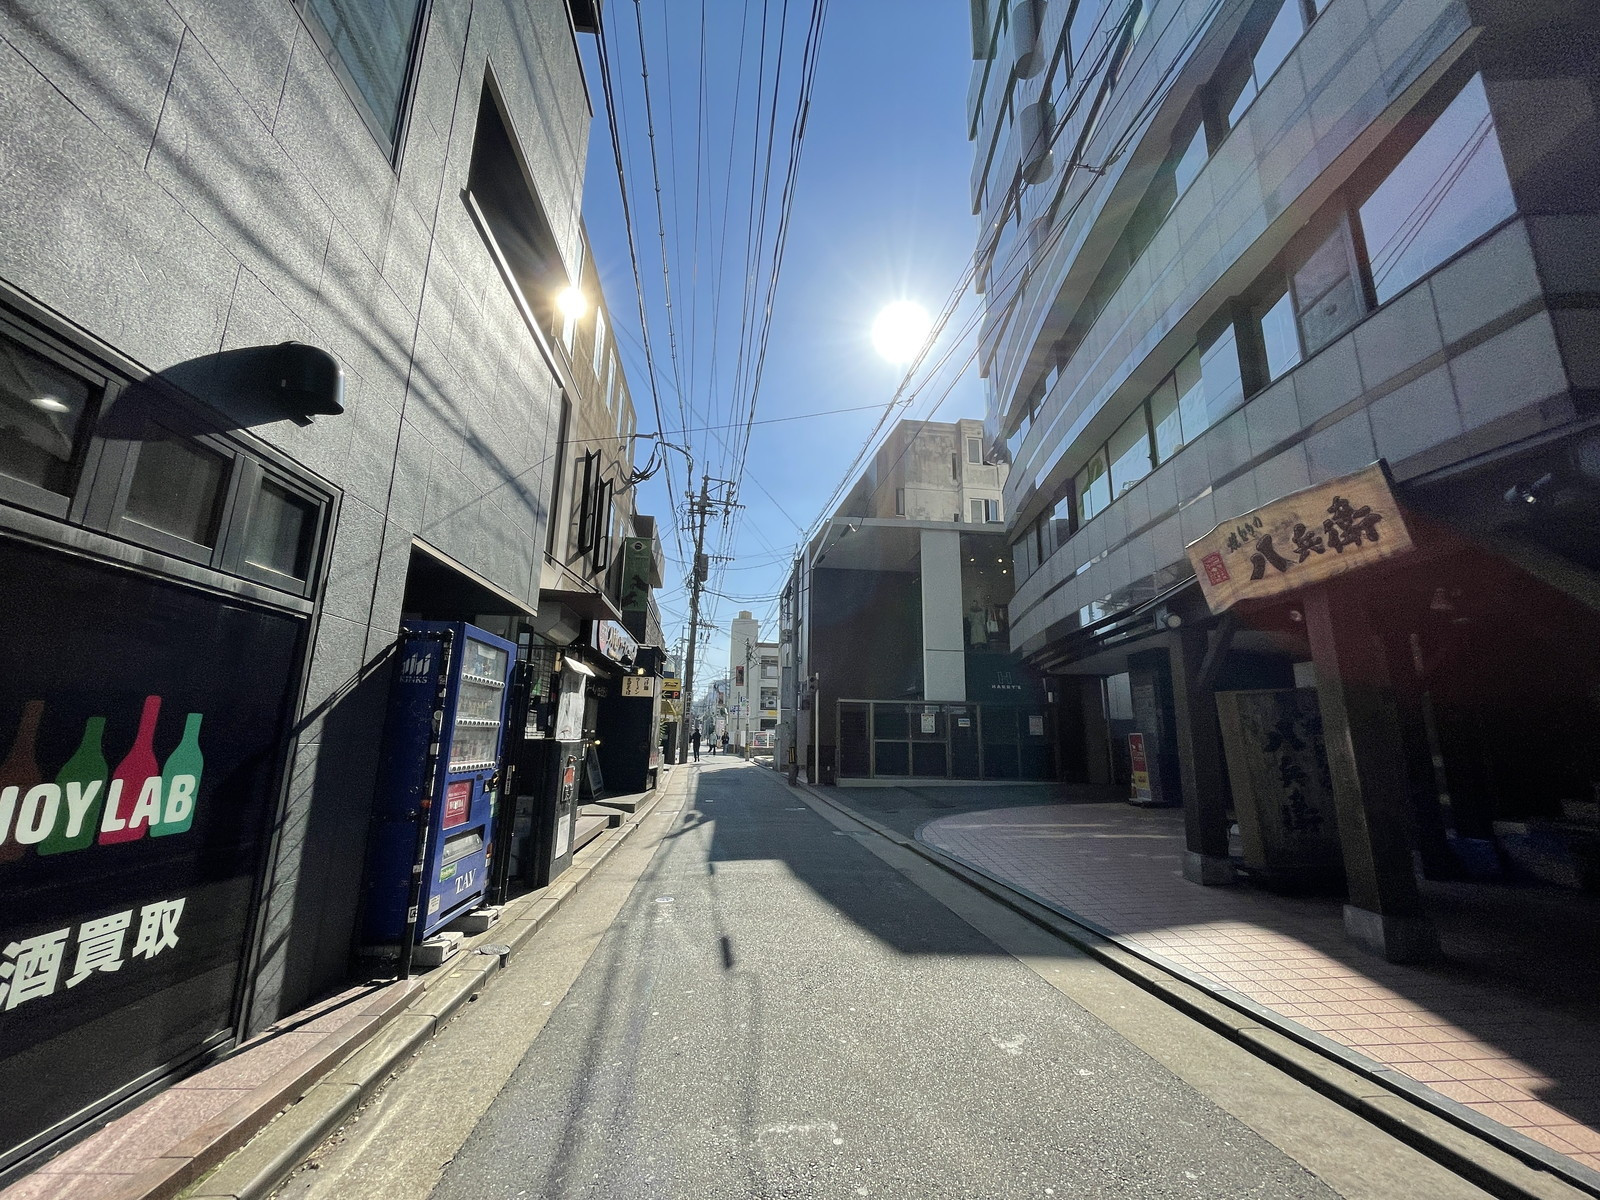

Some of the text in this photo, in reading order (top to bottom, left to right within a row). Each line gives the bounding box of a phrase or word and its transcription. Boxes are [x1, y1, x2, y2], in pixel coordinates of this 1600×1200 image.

[1250, 496, 1383, 582] 八兵衛
[673, 691, 680, 699] P
[0, 897, 186, 1011] 酒買取
